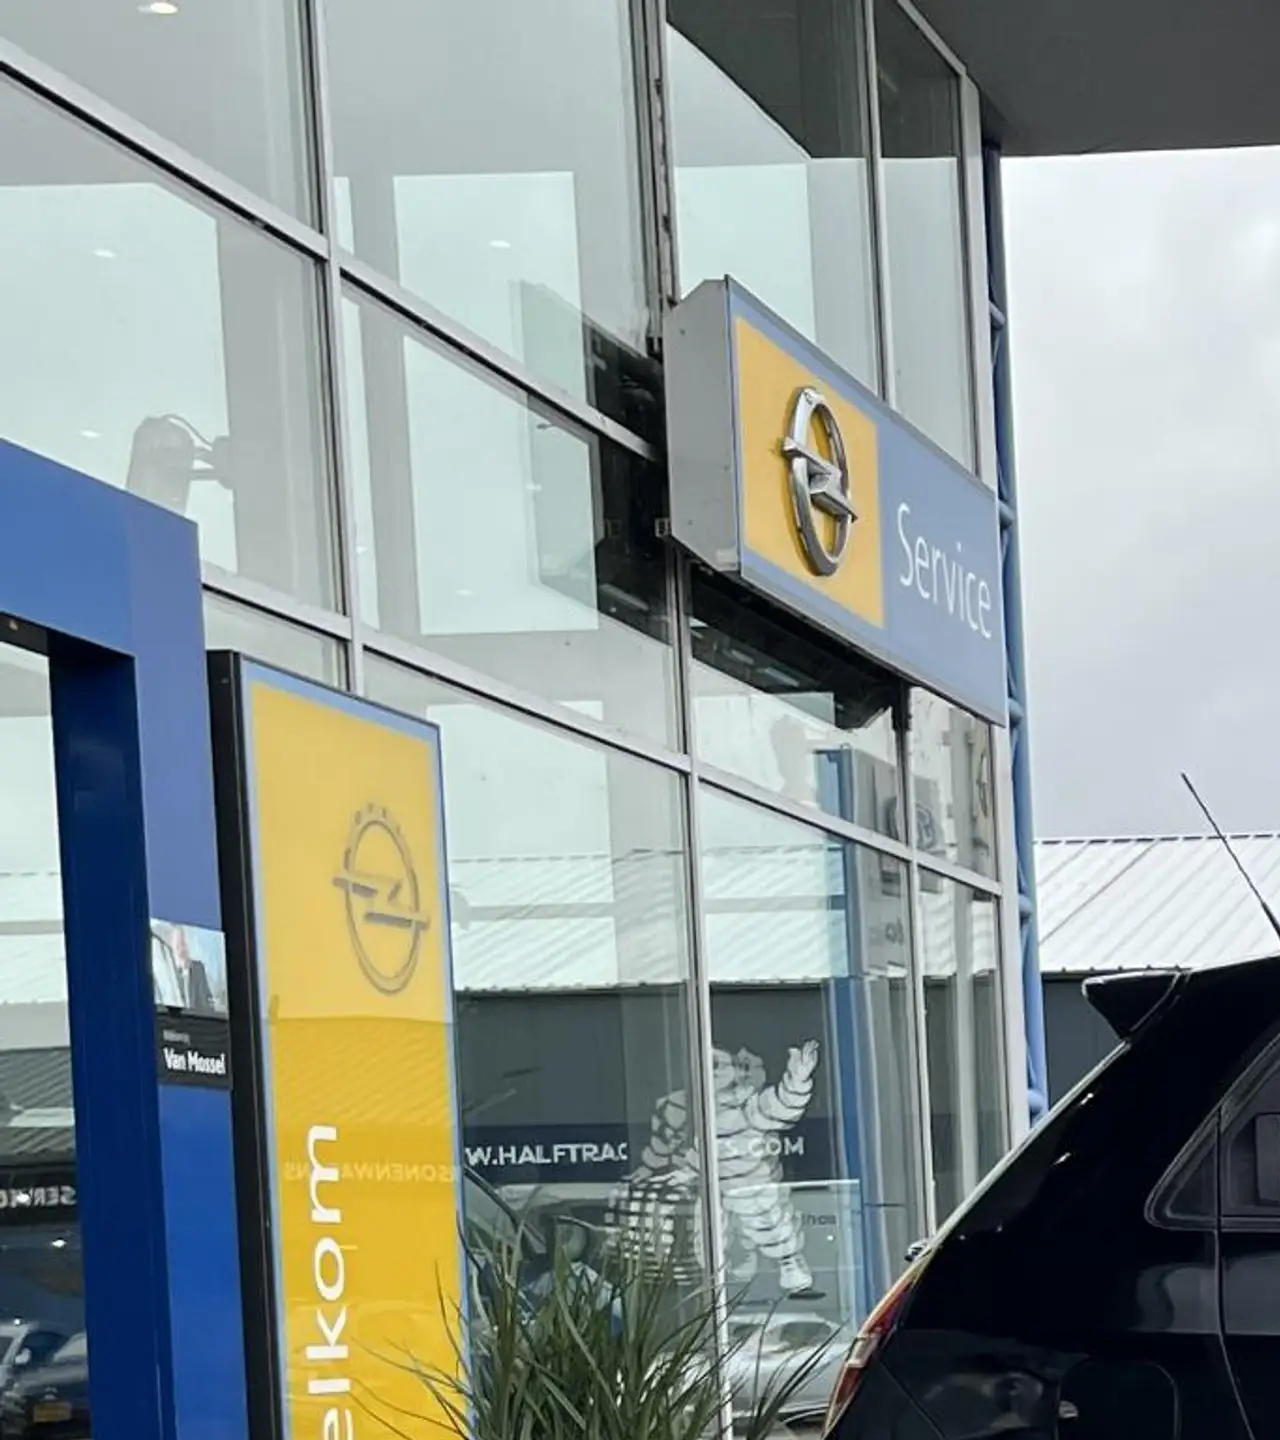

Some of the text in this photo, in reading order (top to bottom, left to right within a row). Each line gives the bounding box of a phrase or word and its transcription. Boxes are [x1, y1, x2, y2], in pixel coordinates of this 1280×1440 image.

[897, 502, 992, 640] Service
[163, 1047, 226, 1075] Van Mossel
